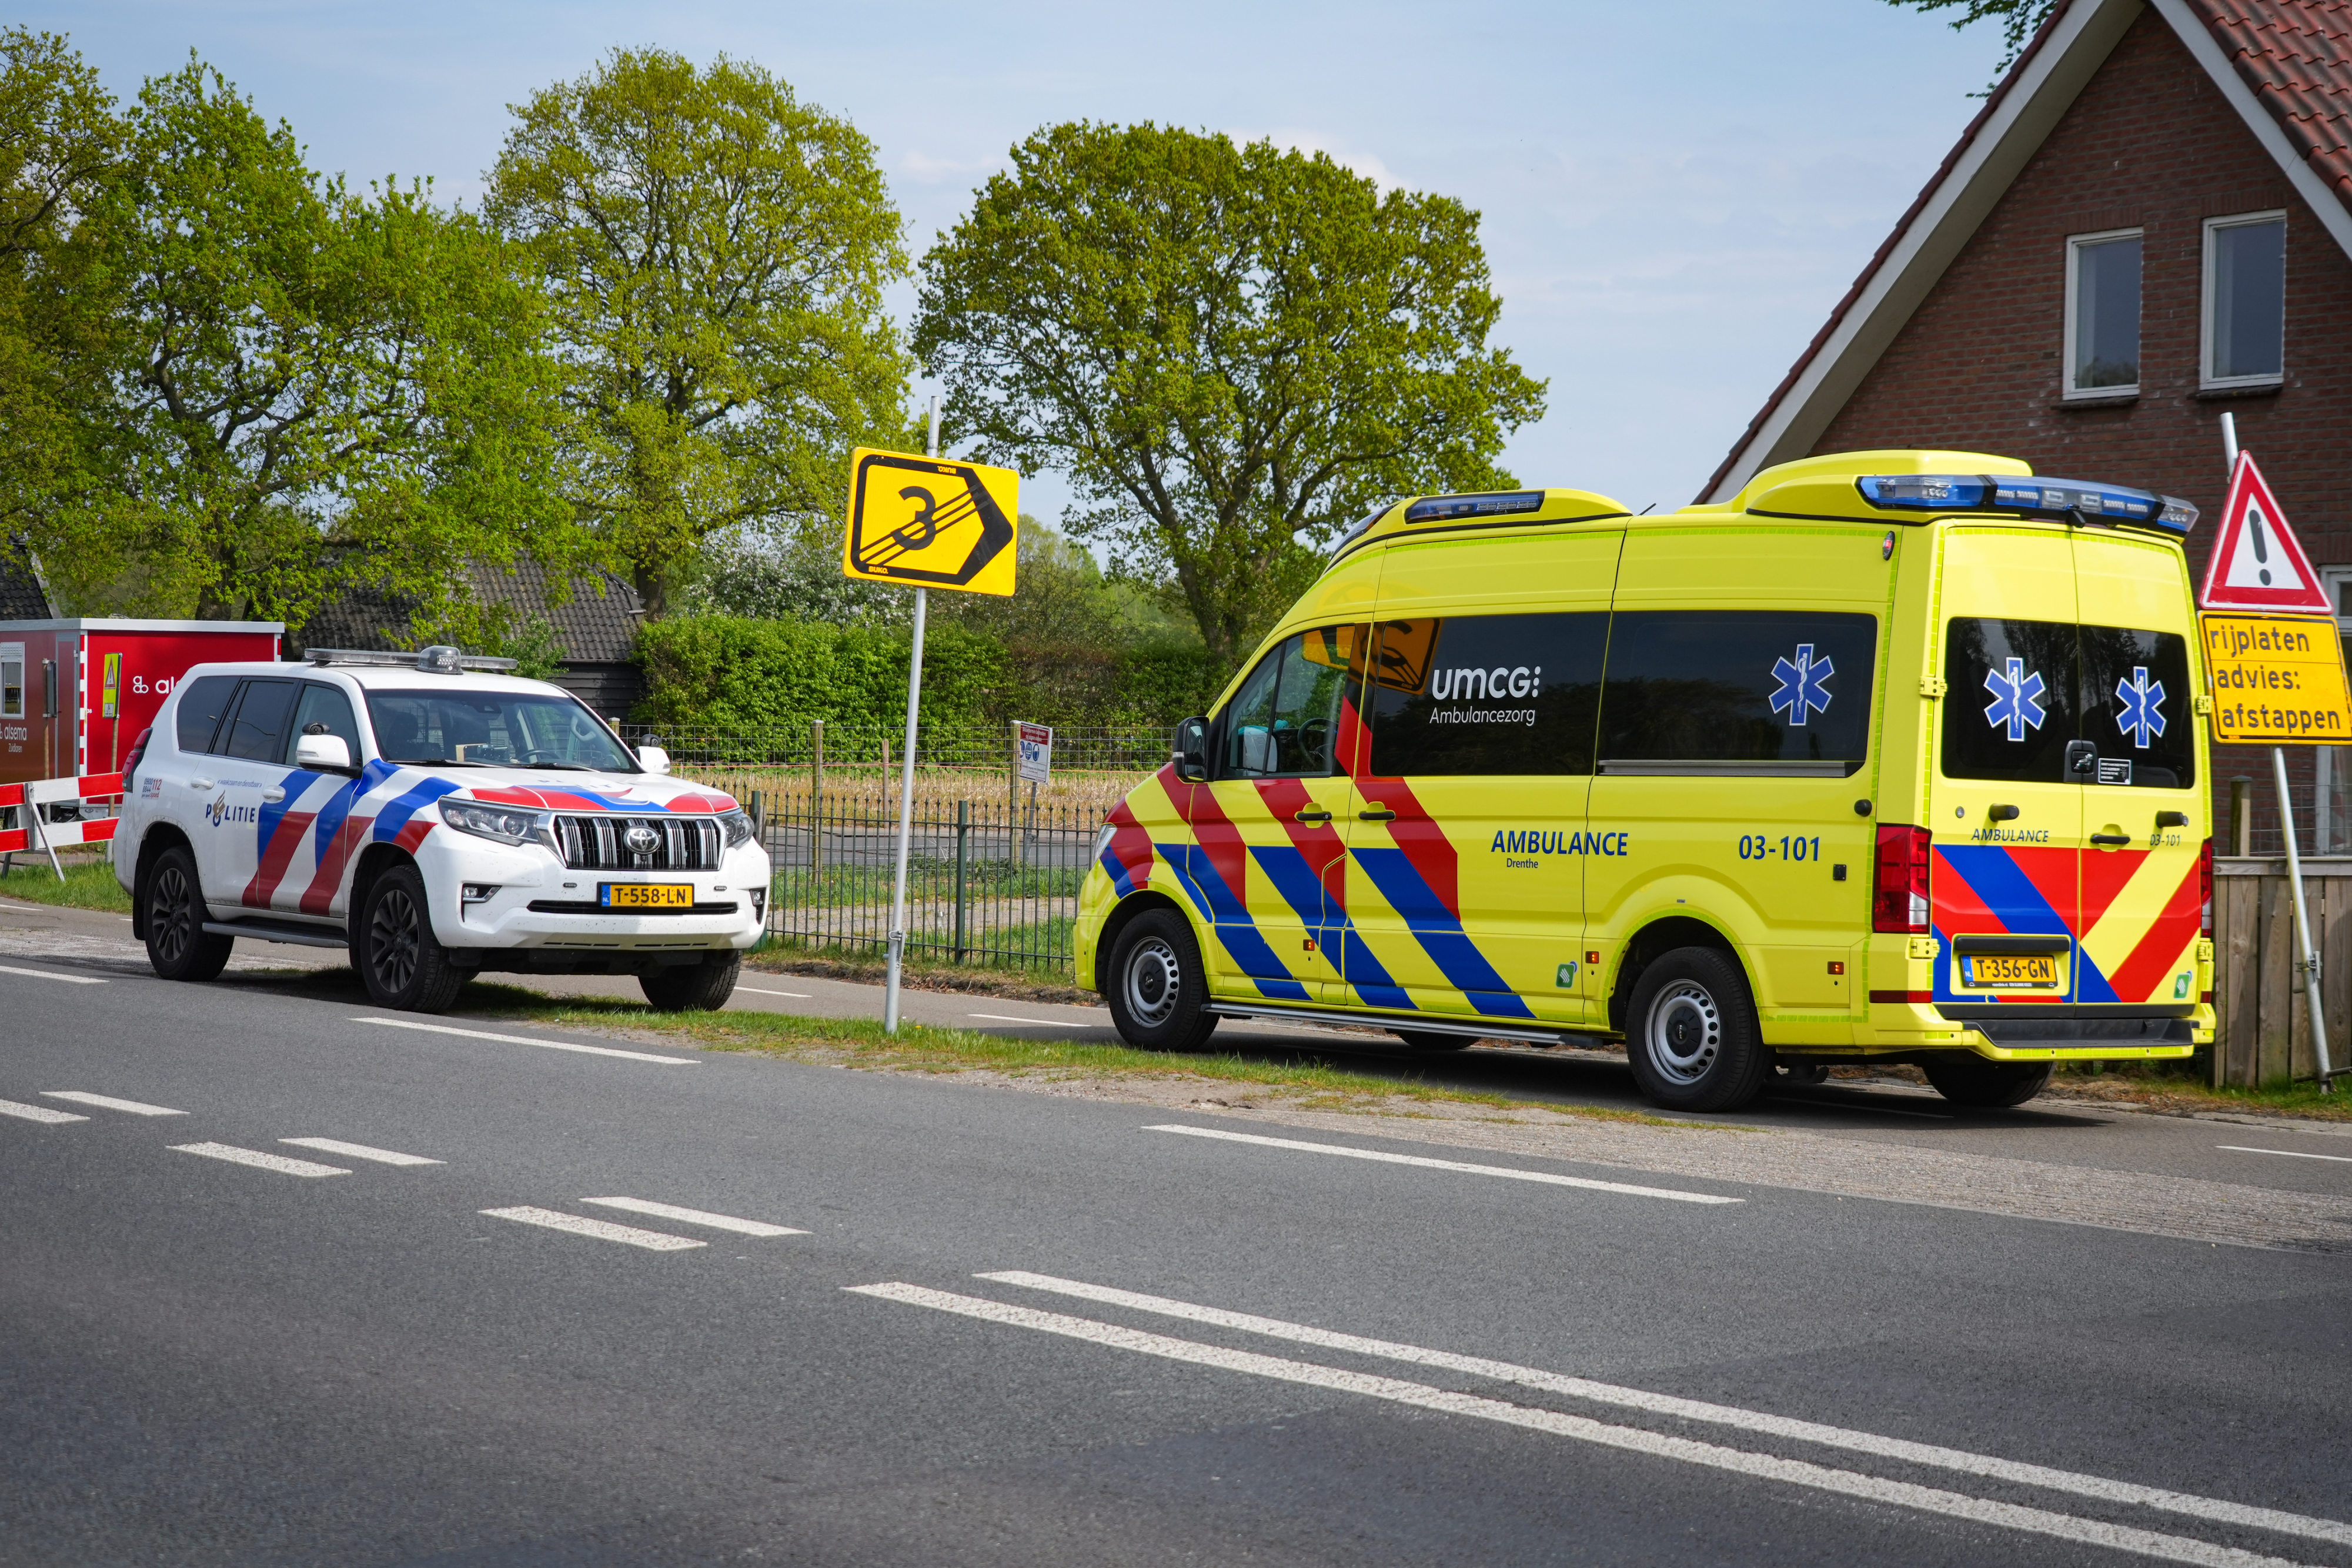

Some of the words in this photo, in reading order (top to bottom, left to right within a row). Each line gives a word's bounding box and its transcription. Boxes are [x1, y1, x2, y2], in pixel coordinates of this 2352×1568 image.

[892, 486, 936, 551] 3
[868, 566, 888, 574] BUKO.
[2210, 625, 2310, 657] rijplaten
[155, 676, 179, 694] al
[2217, 663, 2300, 690] advies:
[1429, 706, 1535, 727] Ambulancezorg
[2222, 703, 2341, 734] afstappen
[4, 723, 27, 741] alsema
[152, 778, 162, 790] 112
[205, 803, 255, 827] POLITIE
[1491, 830, 1628, 856] AMBULANCE
[1971, 828, 2049, 842] AMBULANCE
[2150, 834, 2180, 846] 03-101
[1739, 835, 1819, 861] 03-101
[1506, 858, 1538, 868] Drenthe
[615, 888, 686, 903] T-558-LN
[1976, 959, 2050, 978] T-356-GN
